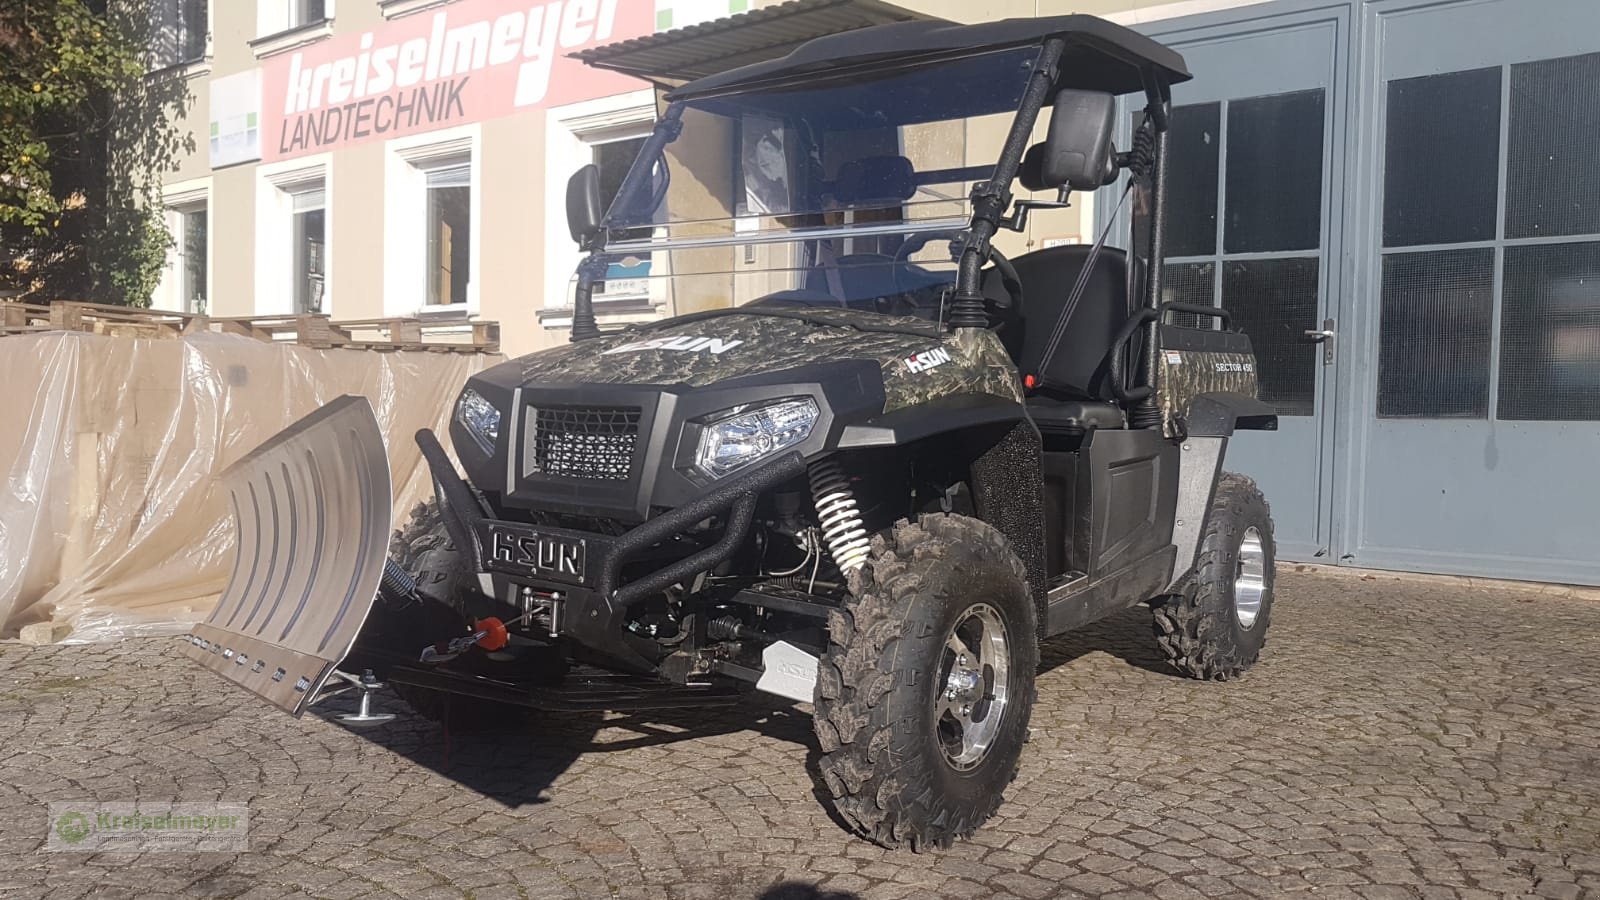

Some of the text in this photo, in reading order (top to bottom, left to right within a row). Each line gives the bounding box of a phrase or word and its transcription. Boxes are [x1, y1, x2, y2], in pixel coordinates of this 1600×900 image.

[279, 76, 470, 154] LANDTECHNIK
[1215, 363, 1253, 372] SECTOR 450
